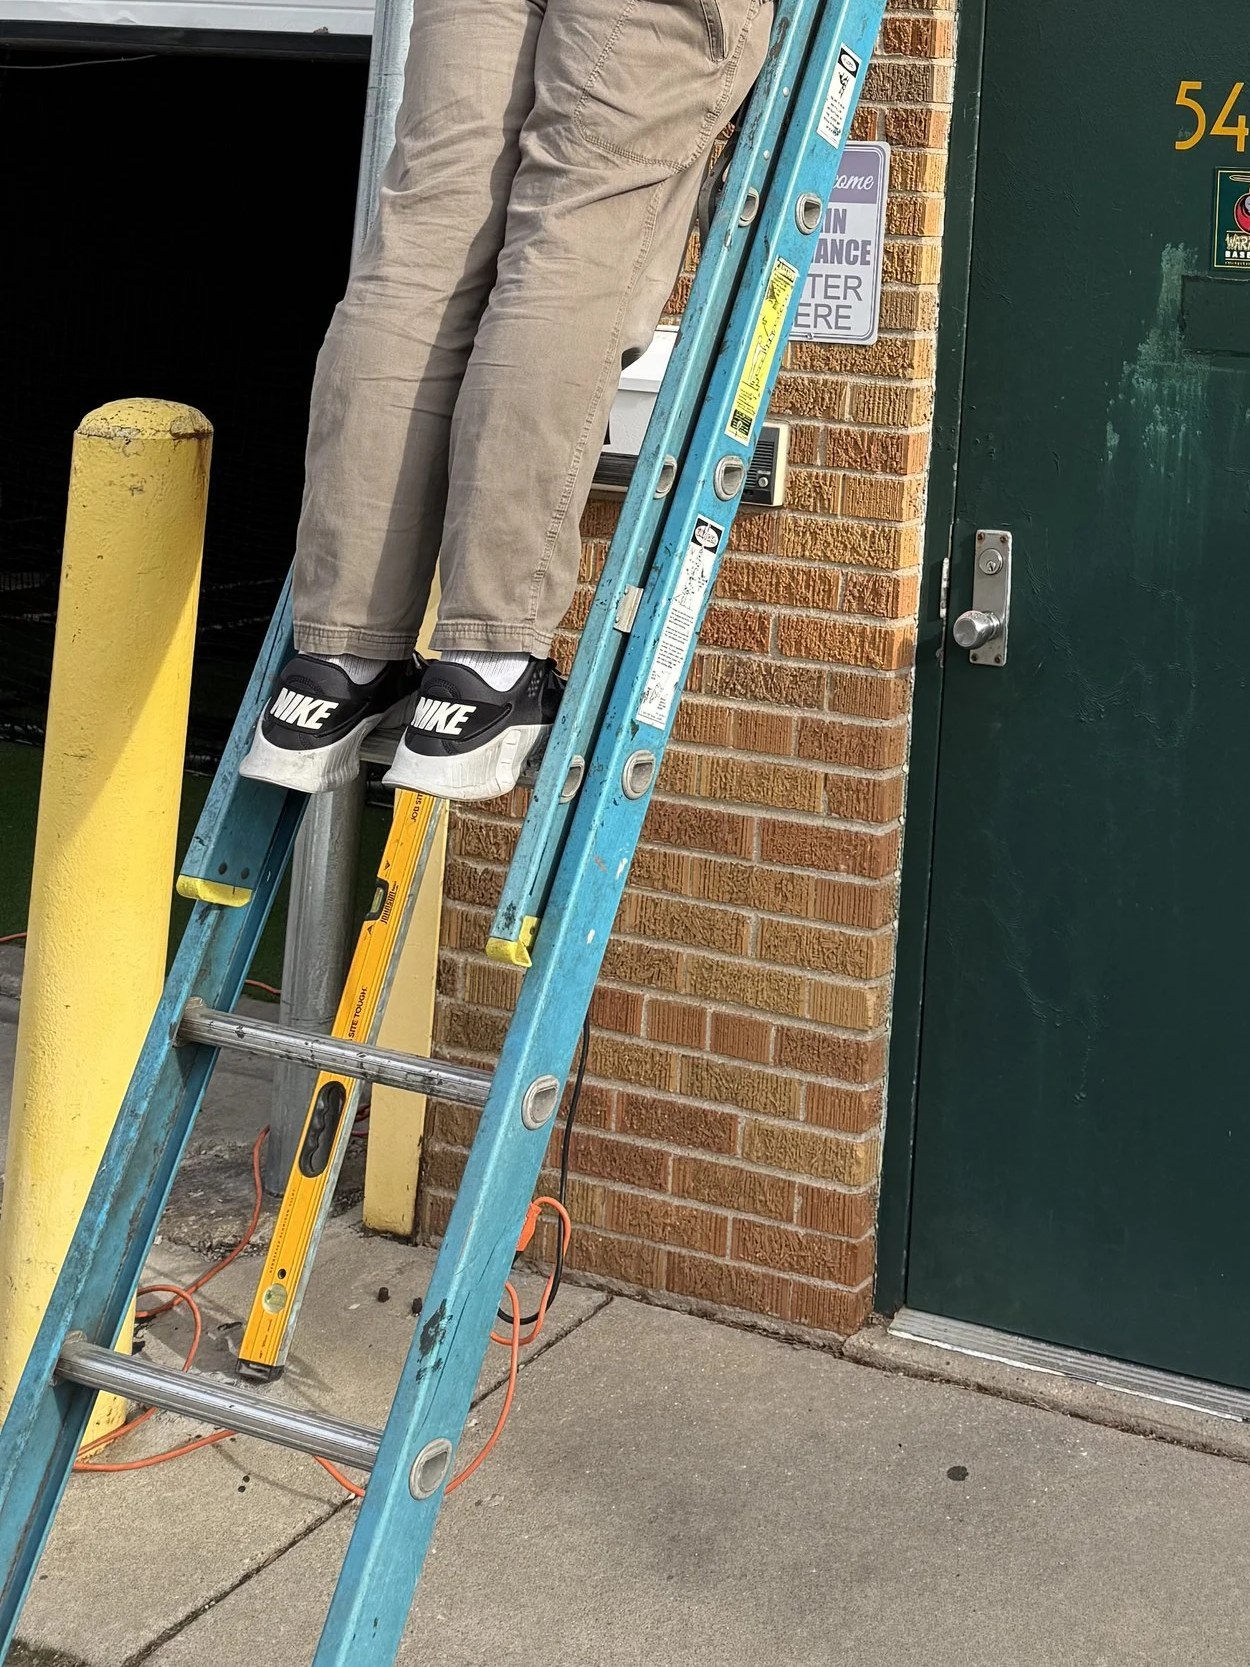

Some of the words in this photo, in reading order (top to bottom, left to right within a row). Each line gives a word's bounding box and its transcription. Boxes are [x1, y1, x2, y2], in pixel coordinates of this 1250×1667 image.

[821, 207, 847, 234] IN
[811, 237, 872, 266] ANCE
[807, 273, 863, 301] TER
[794, 302, 852, 331] ERE
[269, 687, 339, 730] NIKE
[410, 696, 477, 735] NIKE
